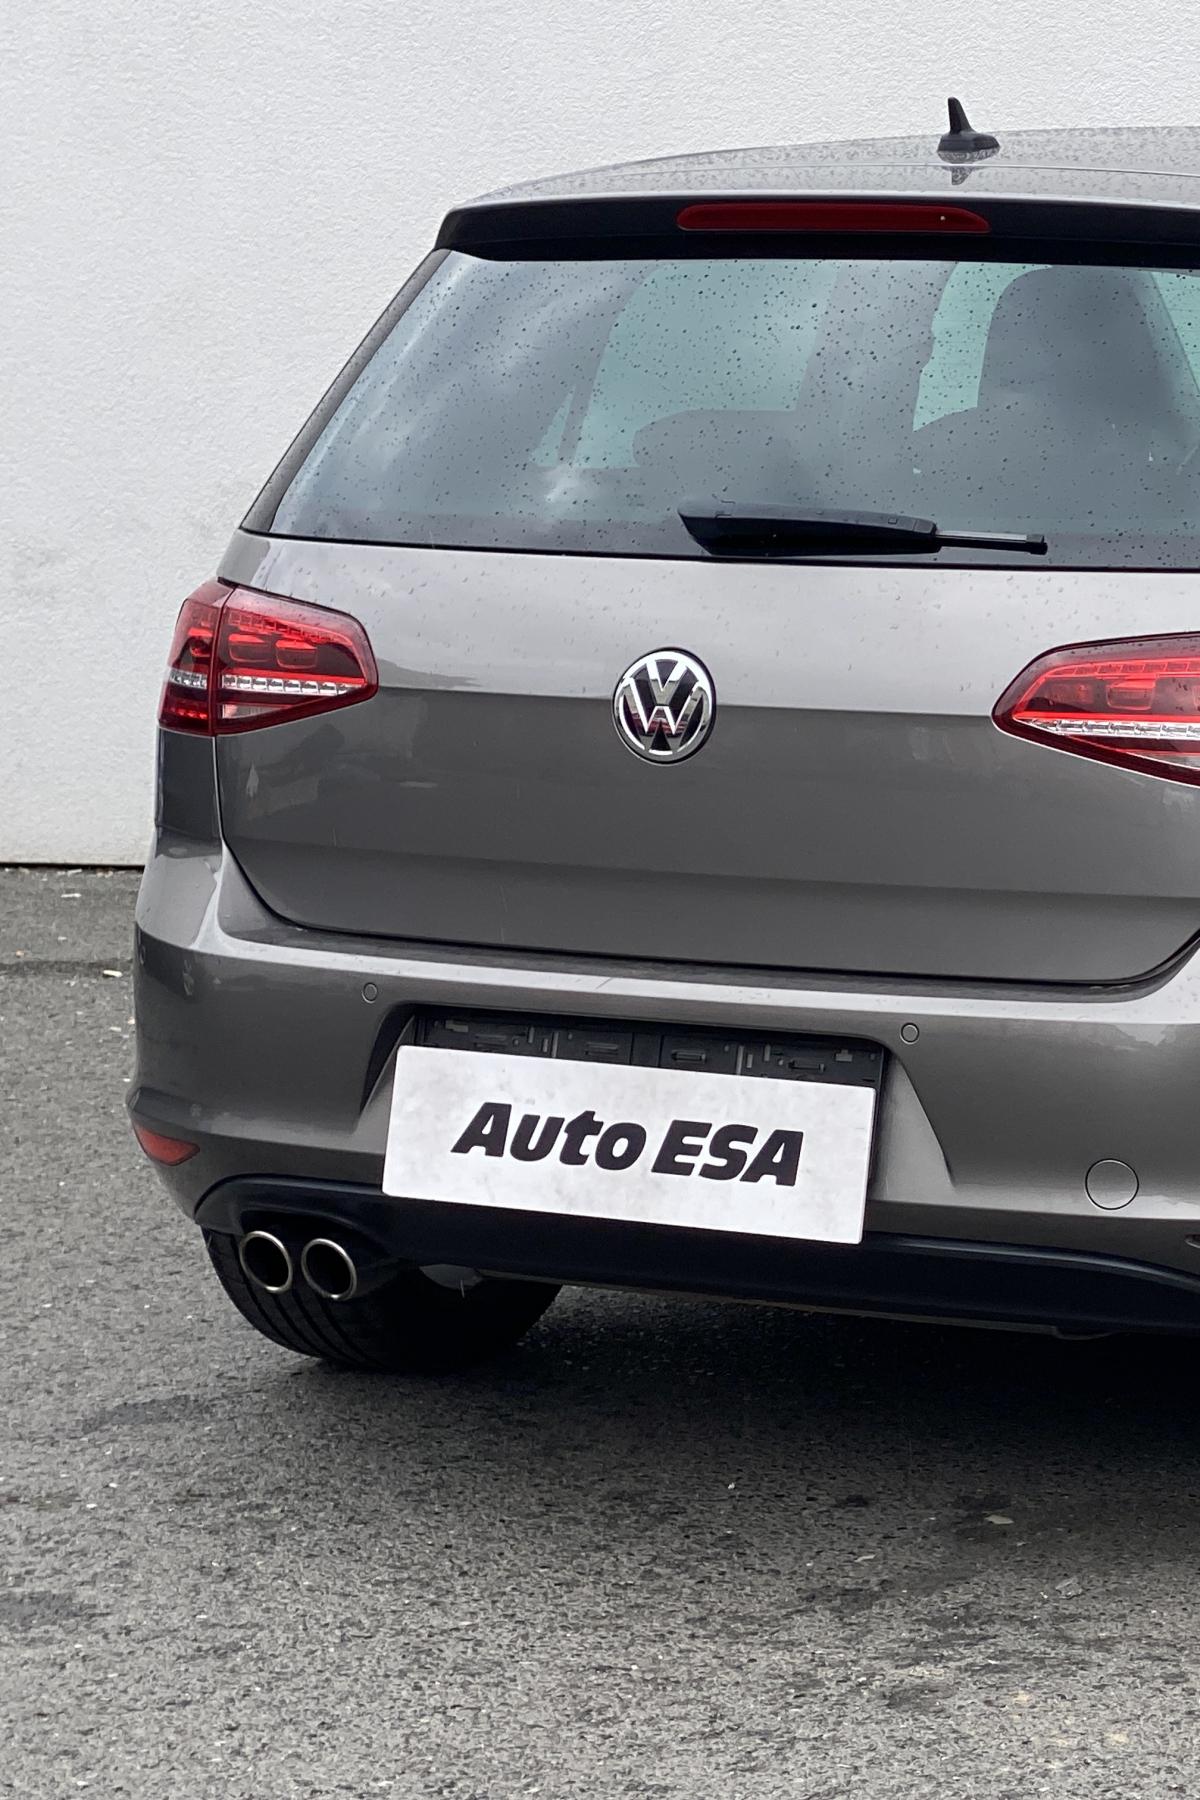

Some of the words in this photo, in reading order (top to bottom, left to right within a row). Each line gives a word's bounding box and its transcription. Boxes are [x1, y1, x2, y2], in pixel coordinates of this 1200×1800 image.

[617, 652, 711, 757] VW
[450, 1102, 647, 1171] Auto
[651, 1119, 804, 1187] ESA
